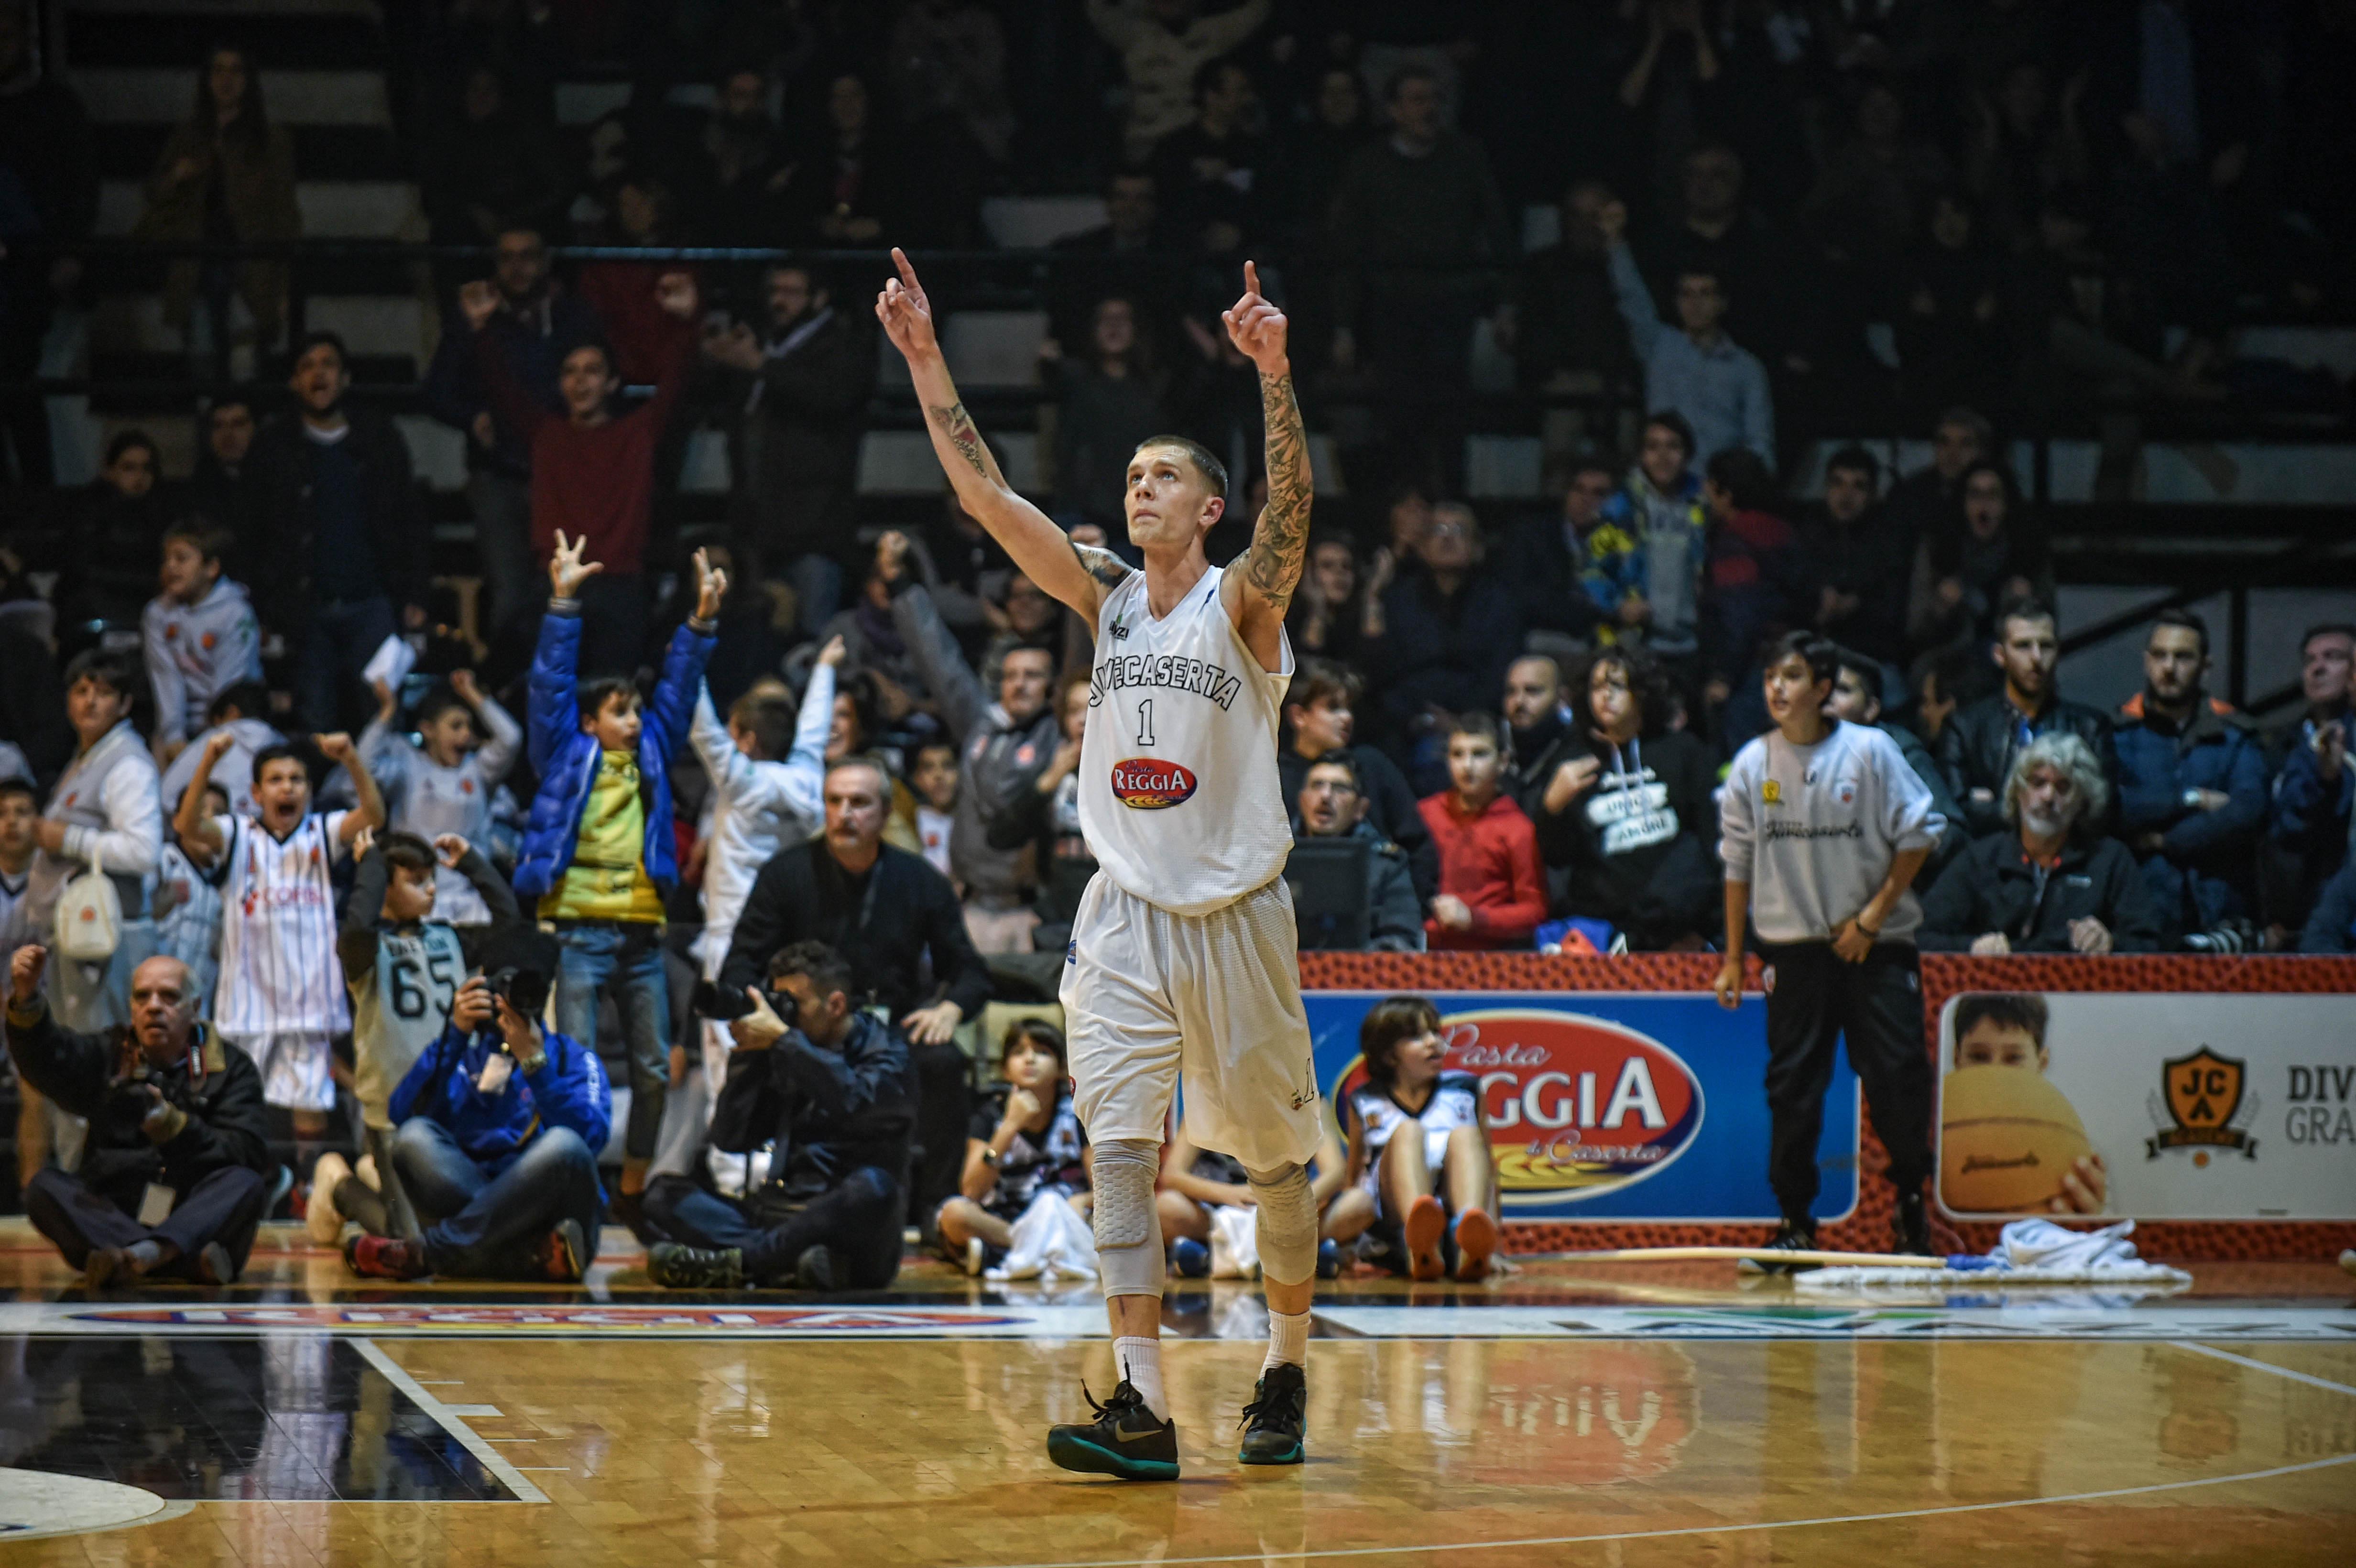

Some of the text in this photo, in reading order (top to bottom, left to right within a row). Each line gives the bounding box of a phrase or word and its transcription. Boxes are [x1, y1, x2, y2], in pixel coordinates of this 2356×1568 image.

[1137, 699, 1155, 746] 1
[1114, 768, 1188, 791] REGGIA
[391, 955, 458, 1019] 65
[1444, 1023, 1552, 1067] Pasta
[2181, 1068, 2227, 1095] JC
[2287, 1065, 2356, 1103] DIV
[2286, 1106, 2356, 1144] GRA
